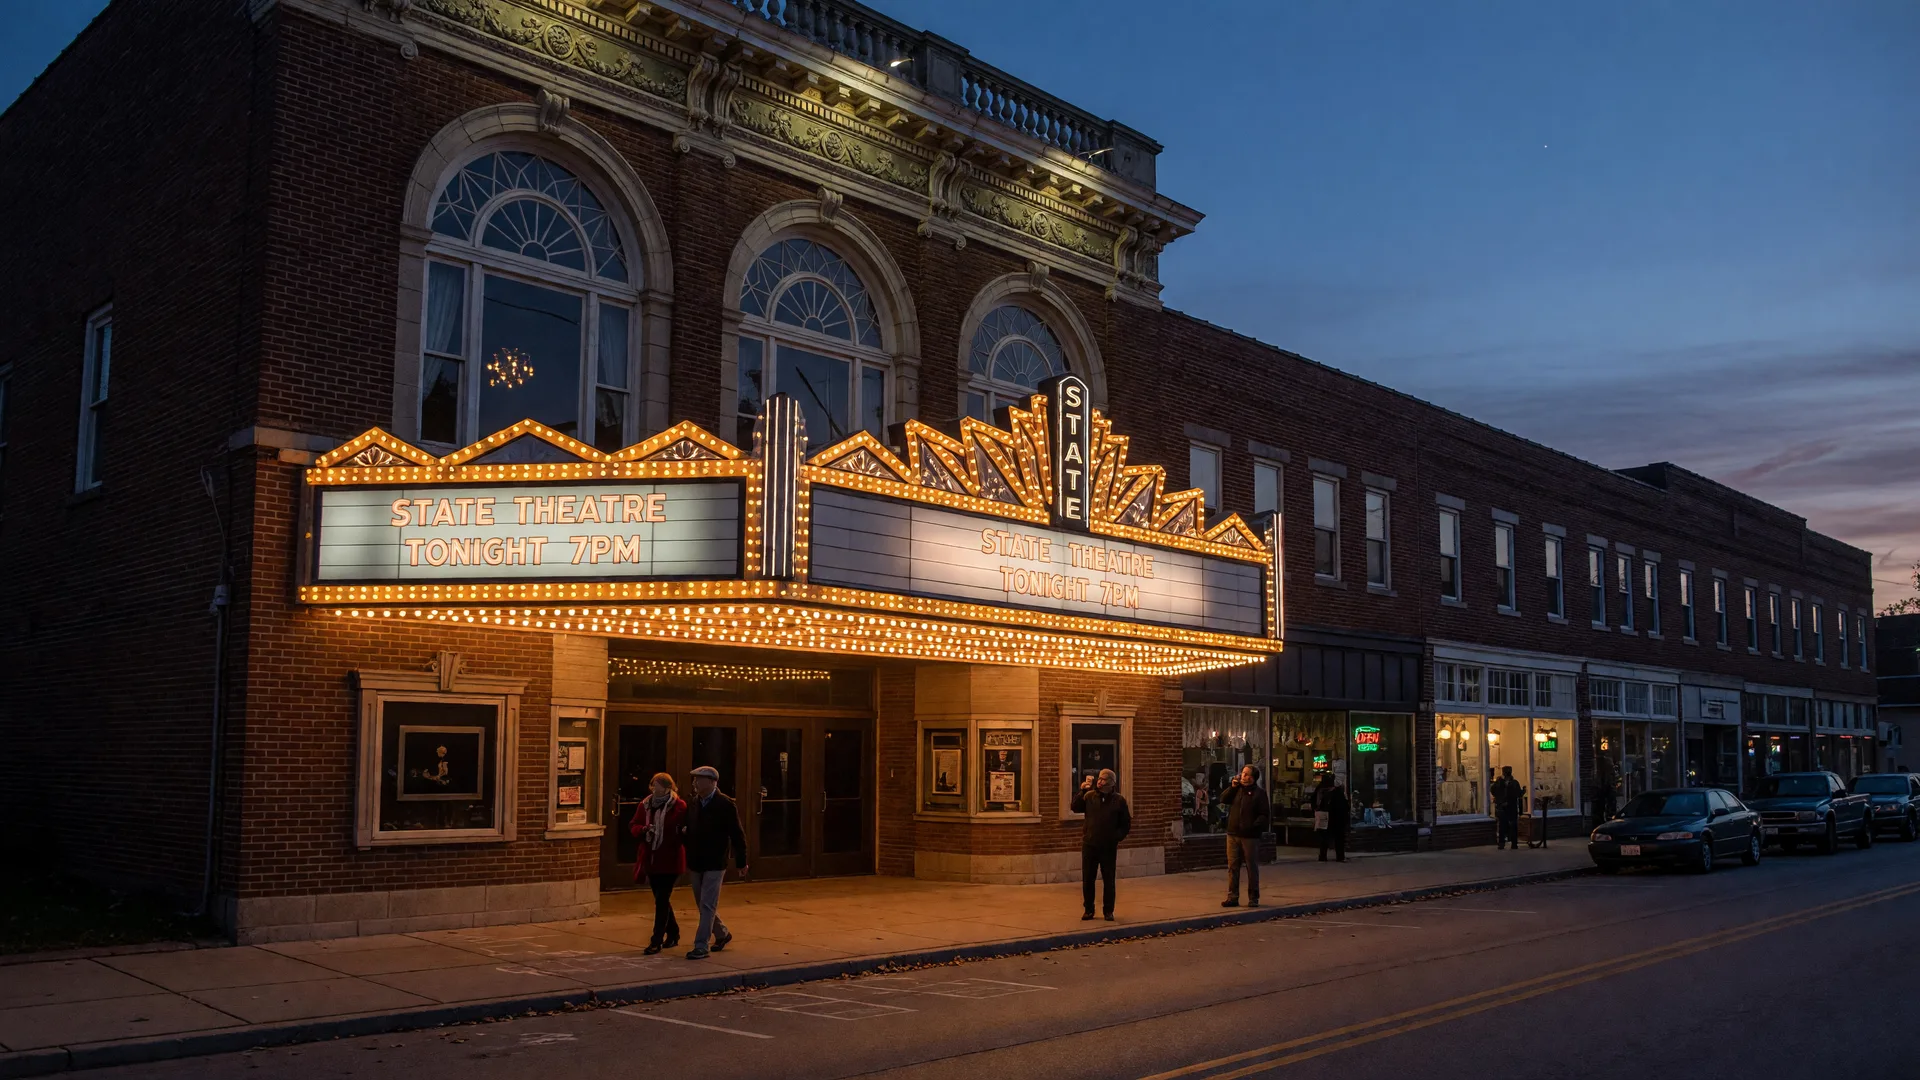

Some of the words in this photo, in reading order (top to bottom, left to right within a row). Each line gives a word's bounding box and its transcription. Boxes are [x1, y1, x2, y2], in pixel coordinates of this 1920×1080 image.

[1065, 386, 1082, 519] STATE
[391, 497, 495, 526] STATE
[513, 493, 667, 525] THEATRE
[404, 536, 549, 566] TONIGHT
[569, 535, 641, 565] 7PM
[981, 528, 1051, 563] STATE
[1068, 544, 1154, 578] THEATRE
[1000, 566, 1089, 602] TONIGHT
[1100, 580, 1140, 609] 7PM
